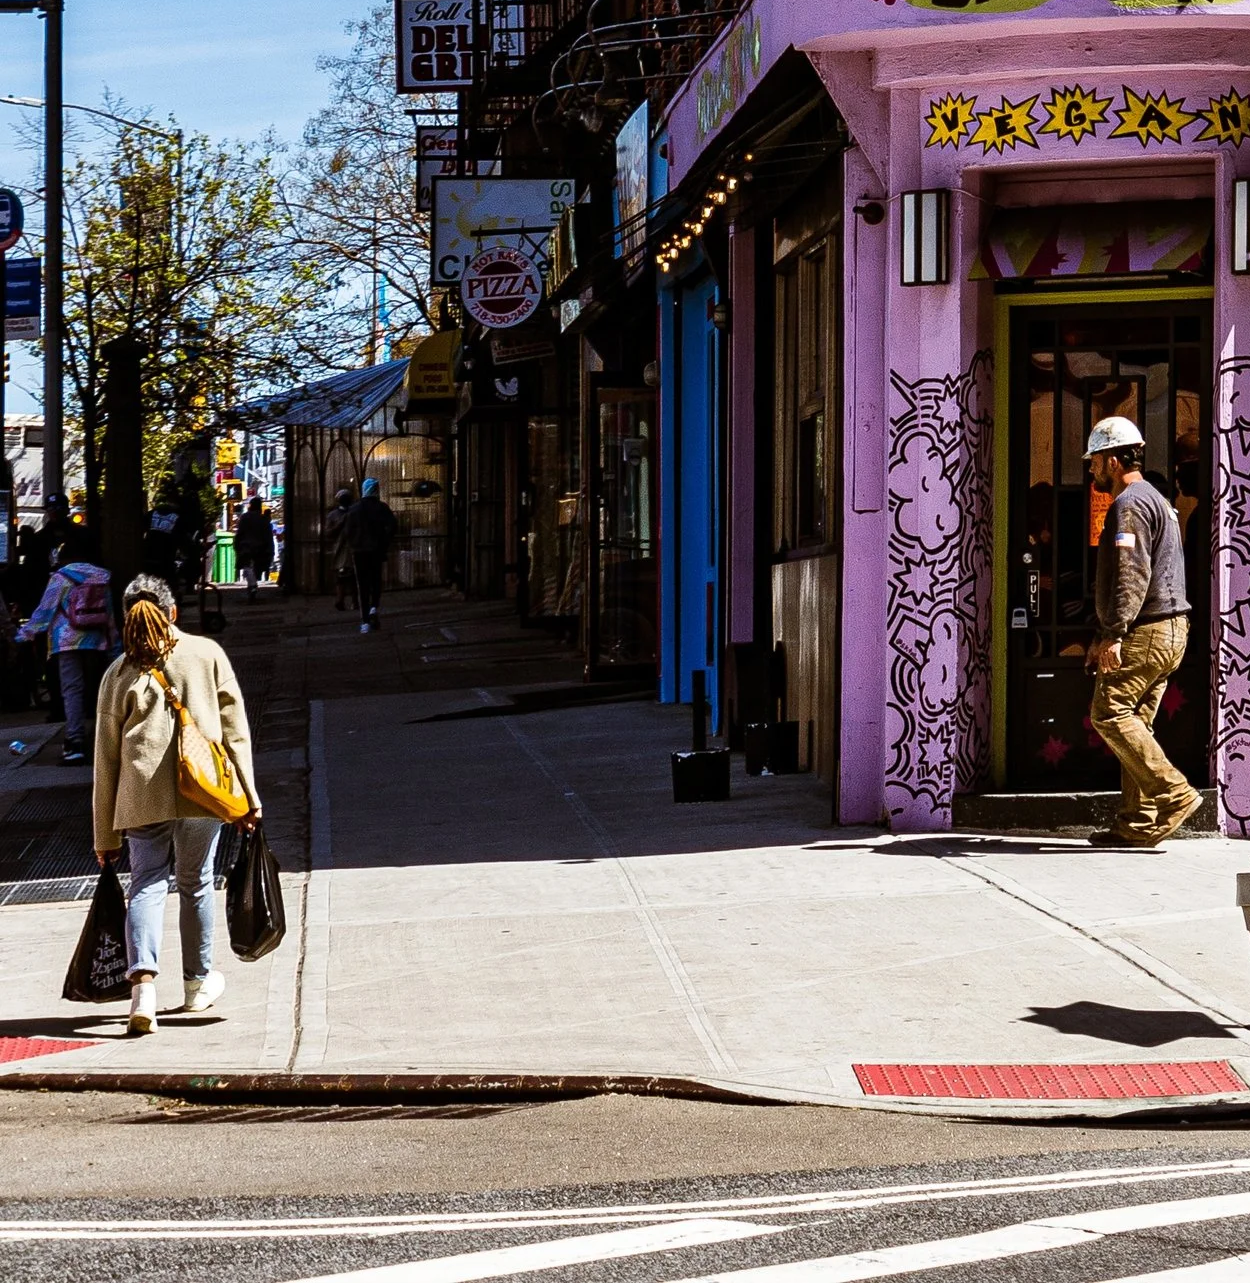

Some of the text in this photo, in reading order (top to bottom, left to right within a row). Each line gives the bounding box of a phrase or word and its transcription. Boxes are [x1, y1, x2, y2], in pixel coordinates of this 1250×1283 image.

[409, 0, 463, 23] Roll
[940, 100, 1241, 139] VEGAN
[466, 274, 539, 299] PIZZA
